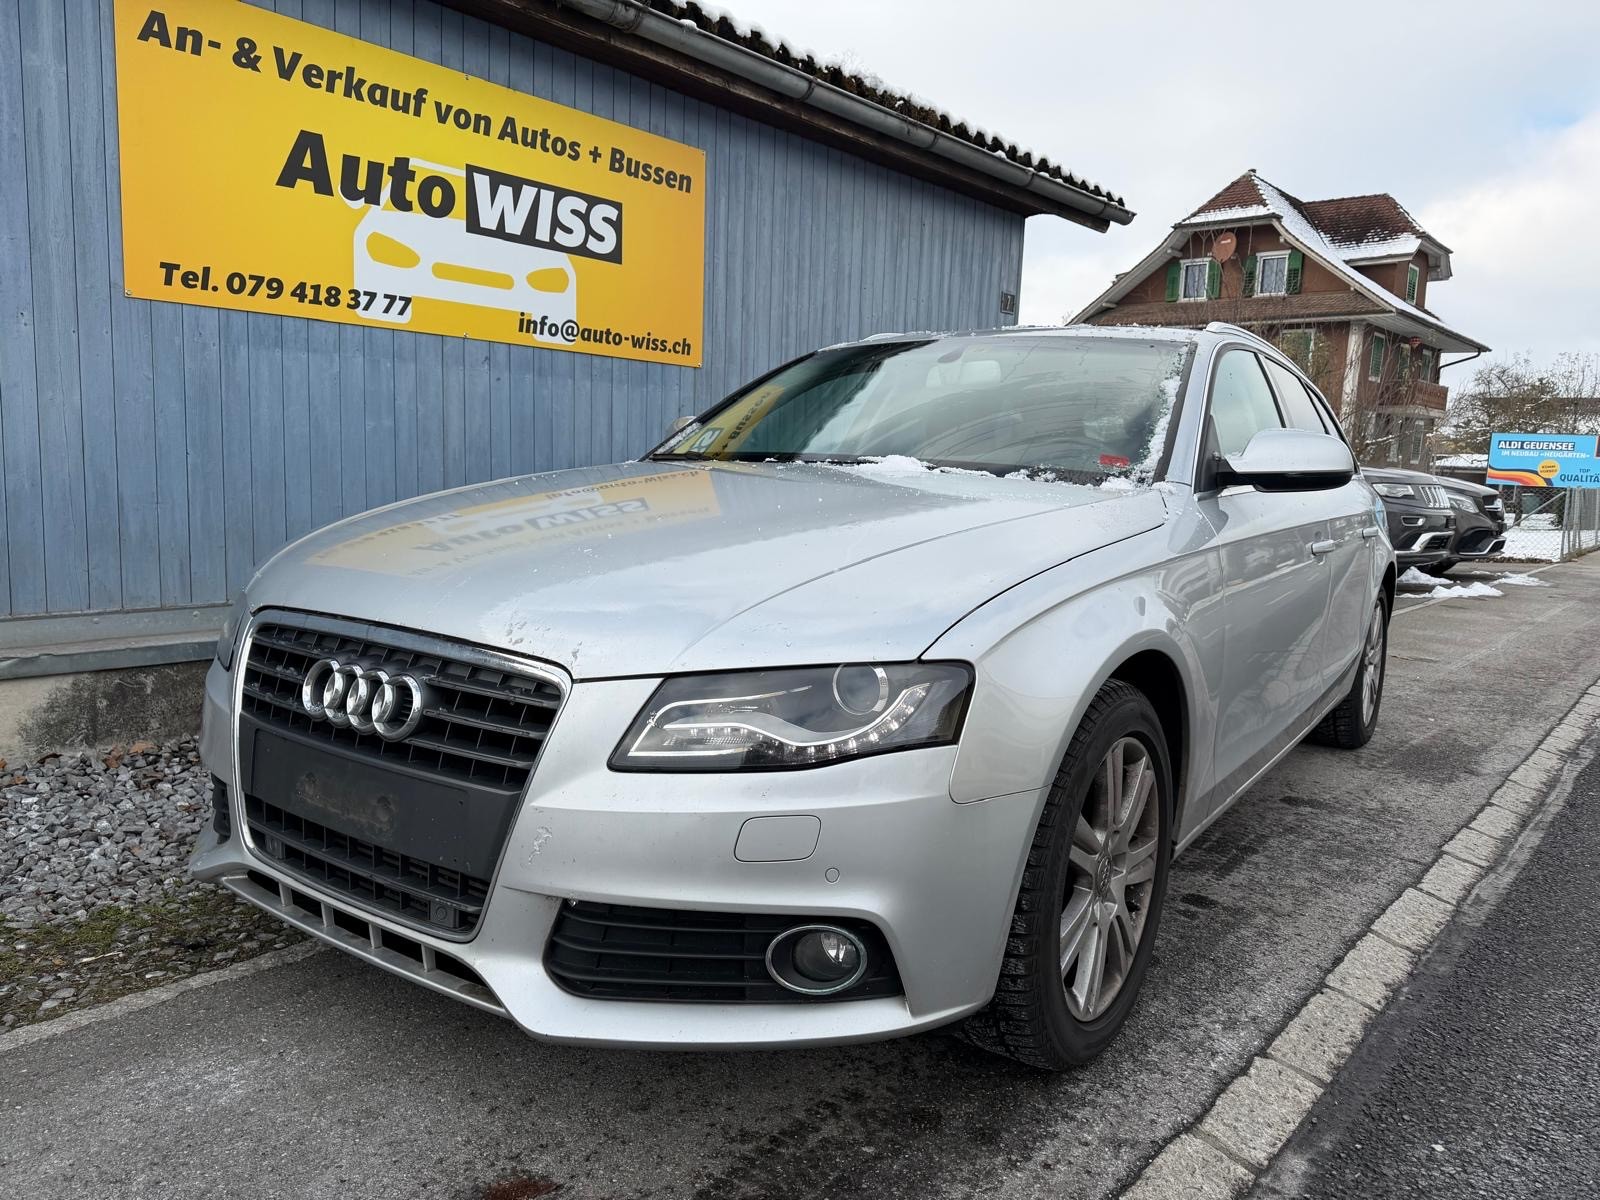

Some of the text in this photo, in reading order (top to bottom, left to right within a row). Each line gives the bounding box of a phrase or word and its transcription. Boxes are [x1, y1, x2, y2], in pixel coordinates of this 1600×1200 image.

[138, 10, 692, 194] An- & Verkauf von Autos + Bussen
[276, 129, 620, 255] Auto WISS
[159, 261, 412, 317] Tel. 079 418 37 77
[518, 312, 692, 357] info@auto-wiss.ch
[1498, 441, 1574, 450] ALDI GEUENSEE
